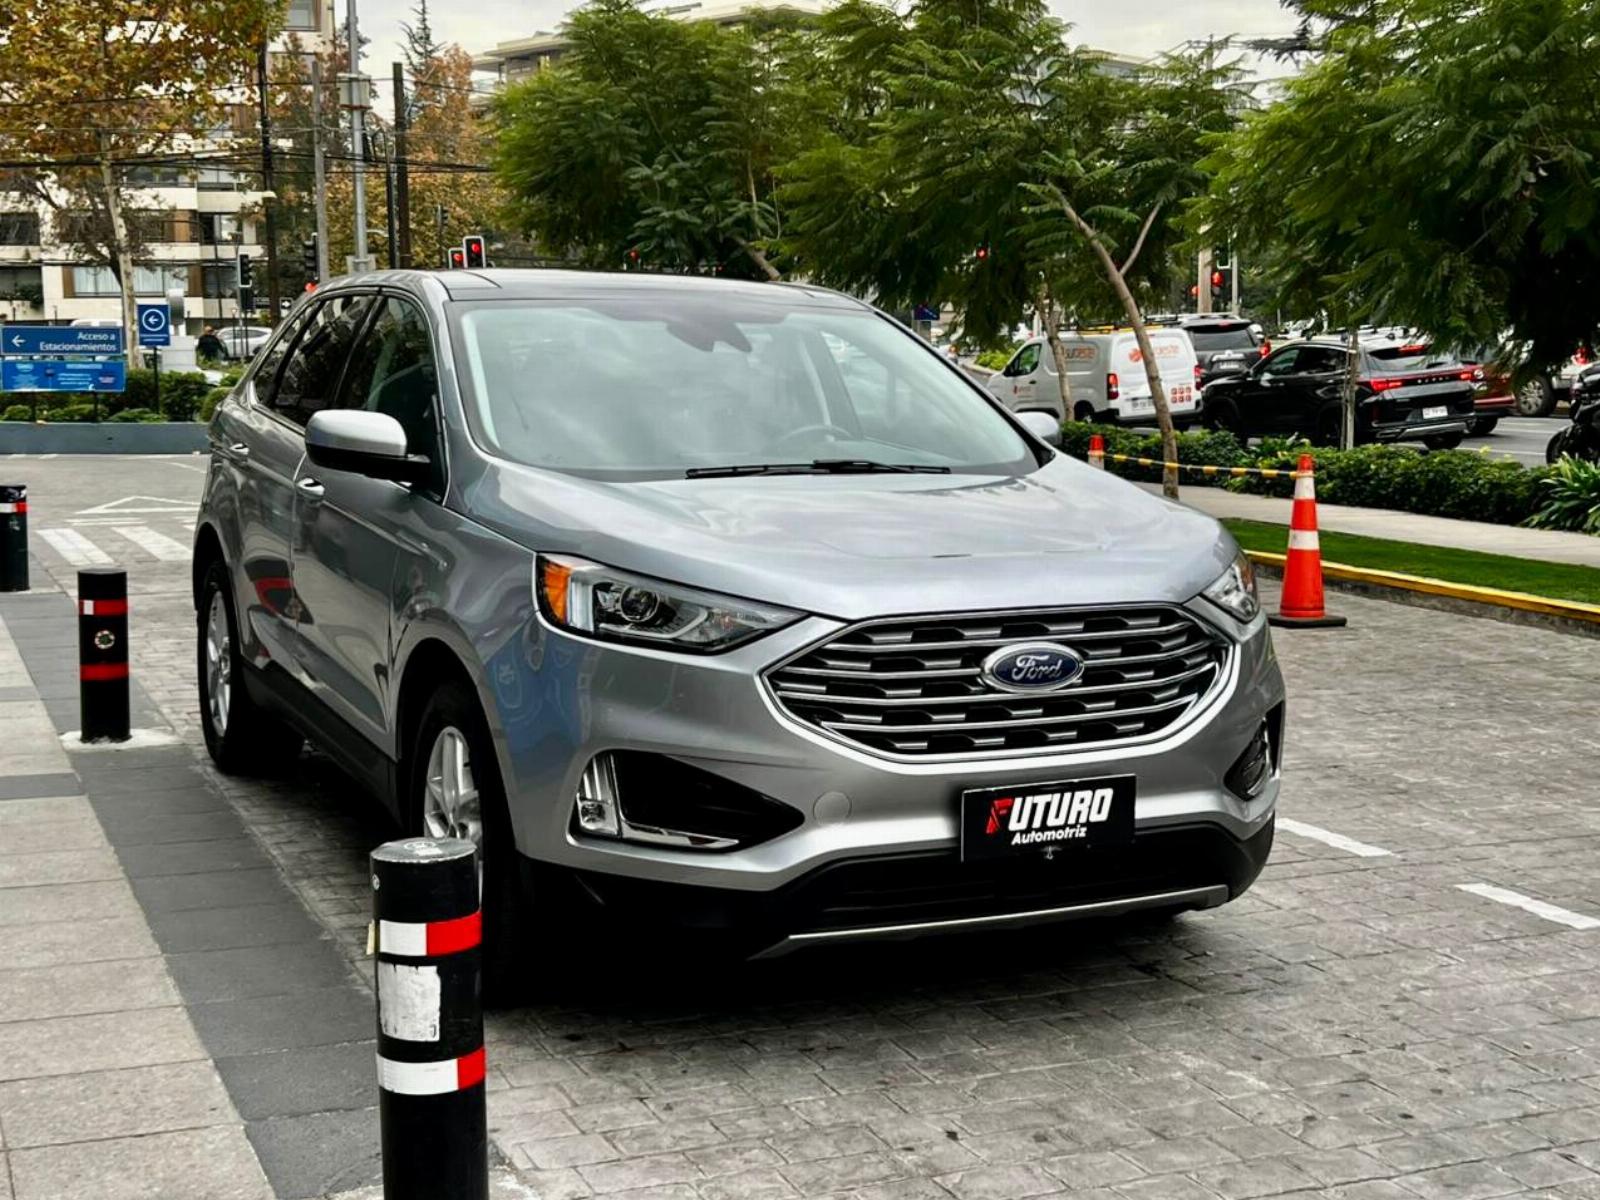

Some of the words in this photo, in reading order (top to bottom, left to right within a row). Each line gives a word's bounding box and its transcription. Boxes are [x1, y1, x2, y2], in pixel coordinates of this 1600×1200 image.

[40, 341, 117, 352] Estacionamientos
[77, 332, 109, 341] Acceso
[110, 333, 116, 341] a
[1011, 654, 1063, 682] Ford
[986, 787, 1114, 834] FUTURO
[1011, 825, 1088, 846] Automotriz
